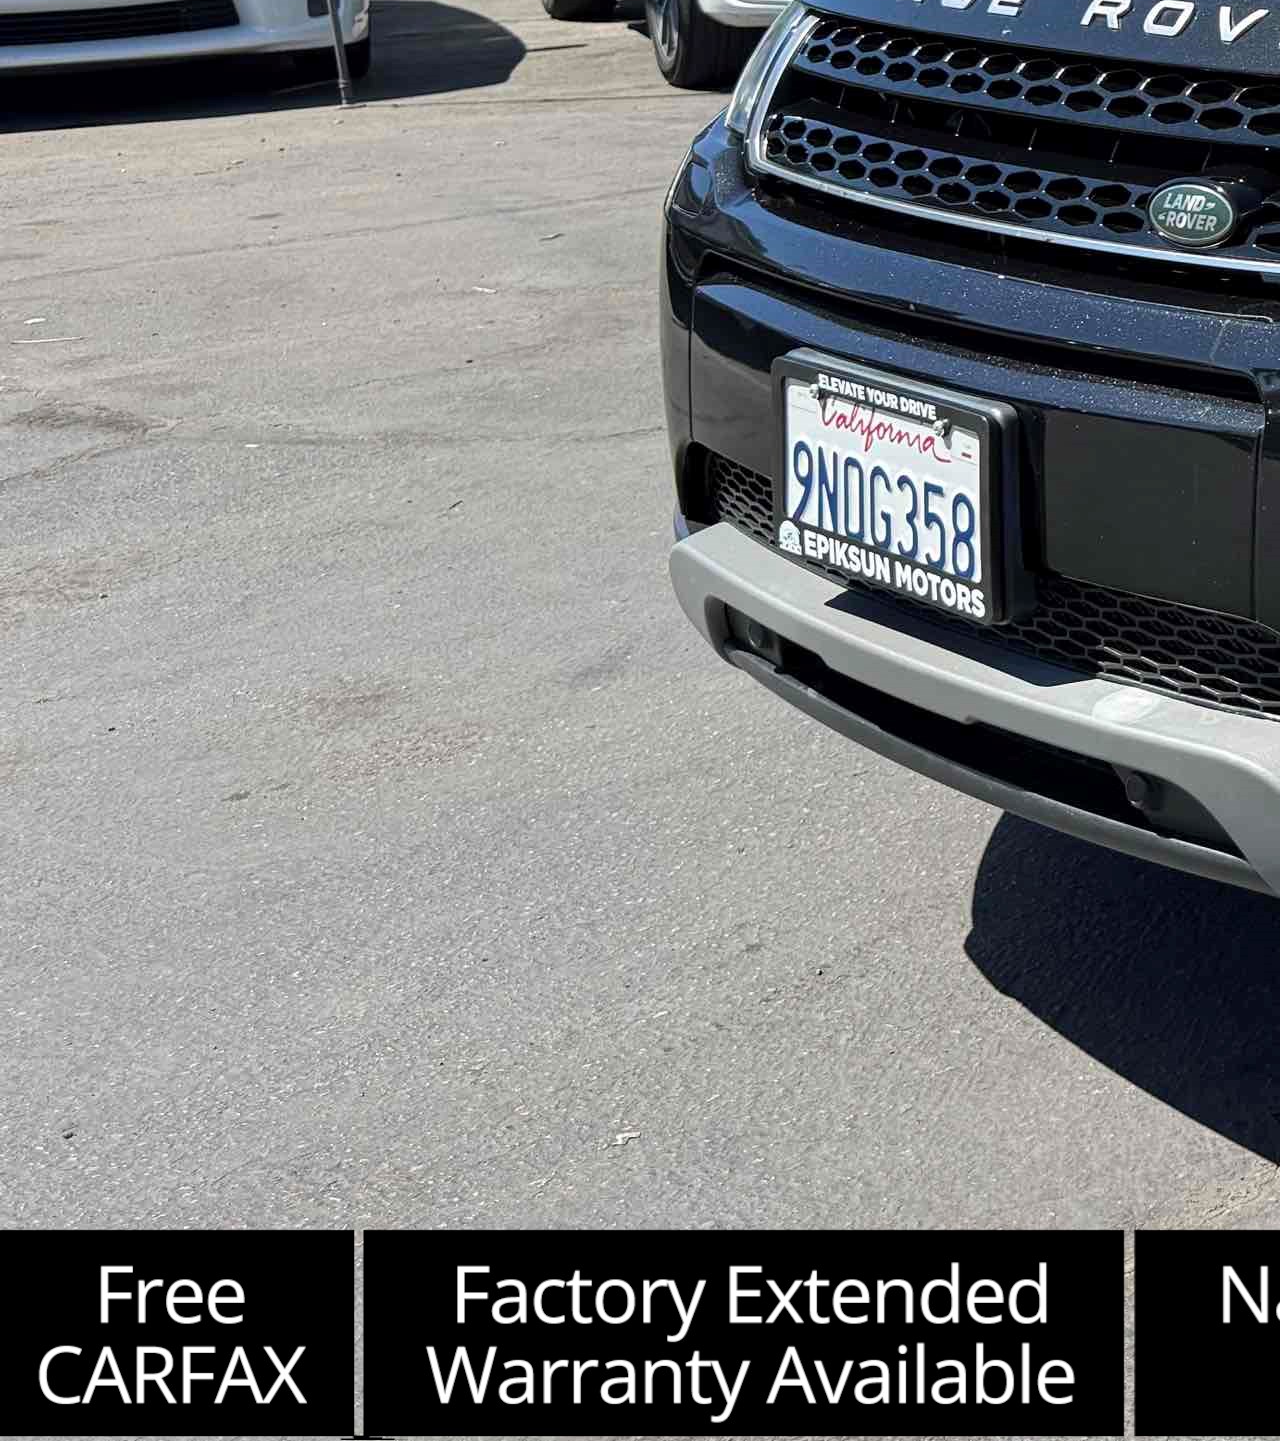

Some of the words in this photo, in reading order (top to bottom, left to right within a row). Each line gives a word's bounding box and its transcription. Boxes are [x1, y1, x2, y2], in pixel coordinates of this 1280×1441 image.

[818, 373, 865, 402] ELEVATE
[866, 386, 899, 410] YOUR
[900, 398, 937, 421] DRIVE
[819, 398, 952, 464] California
[804, 530, 890, 583] EPIKSUN
[896, 564, 986, 618] MOTORS
